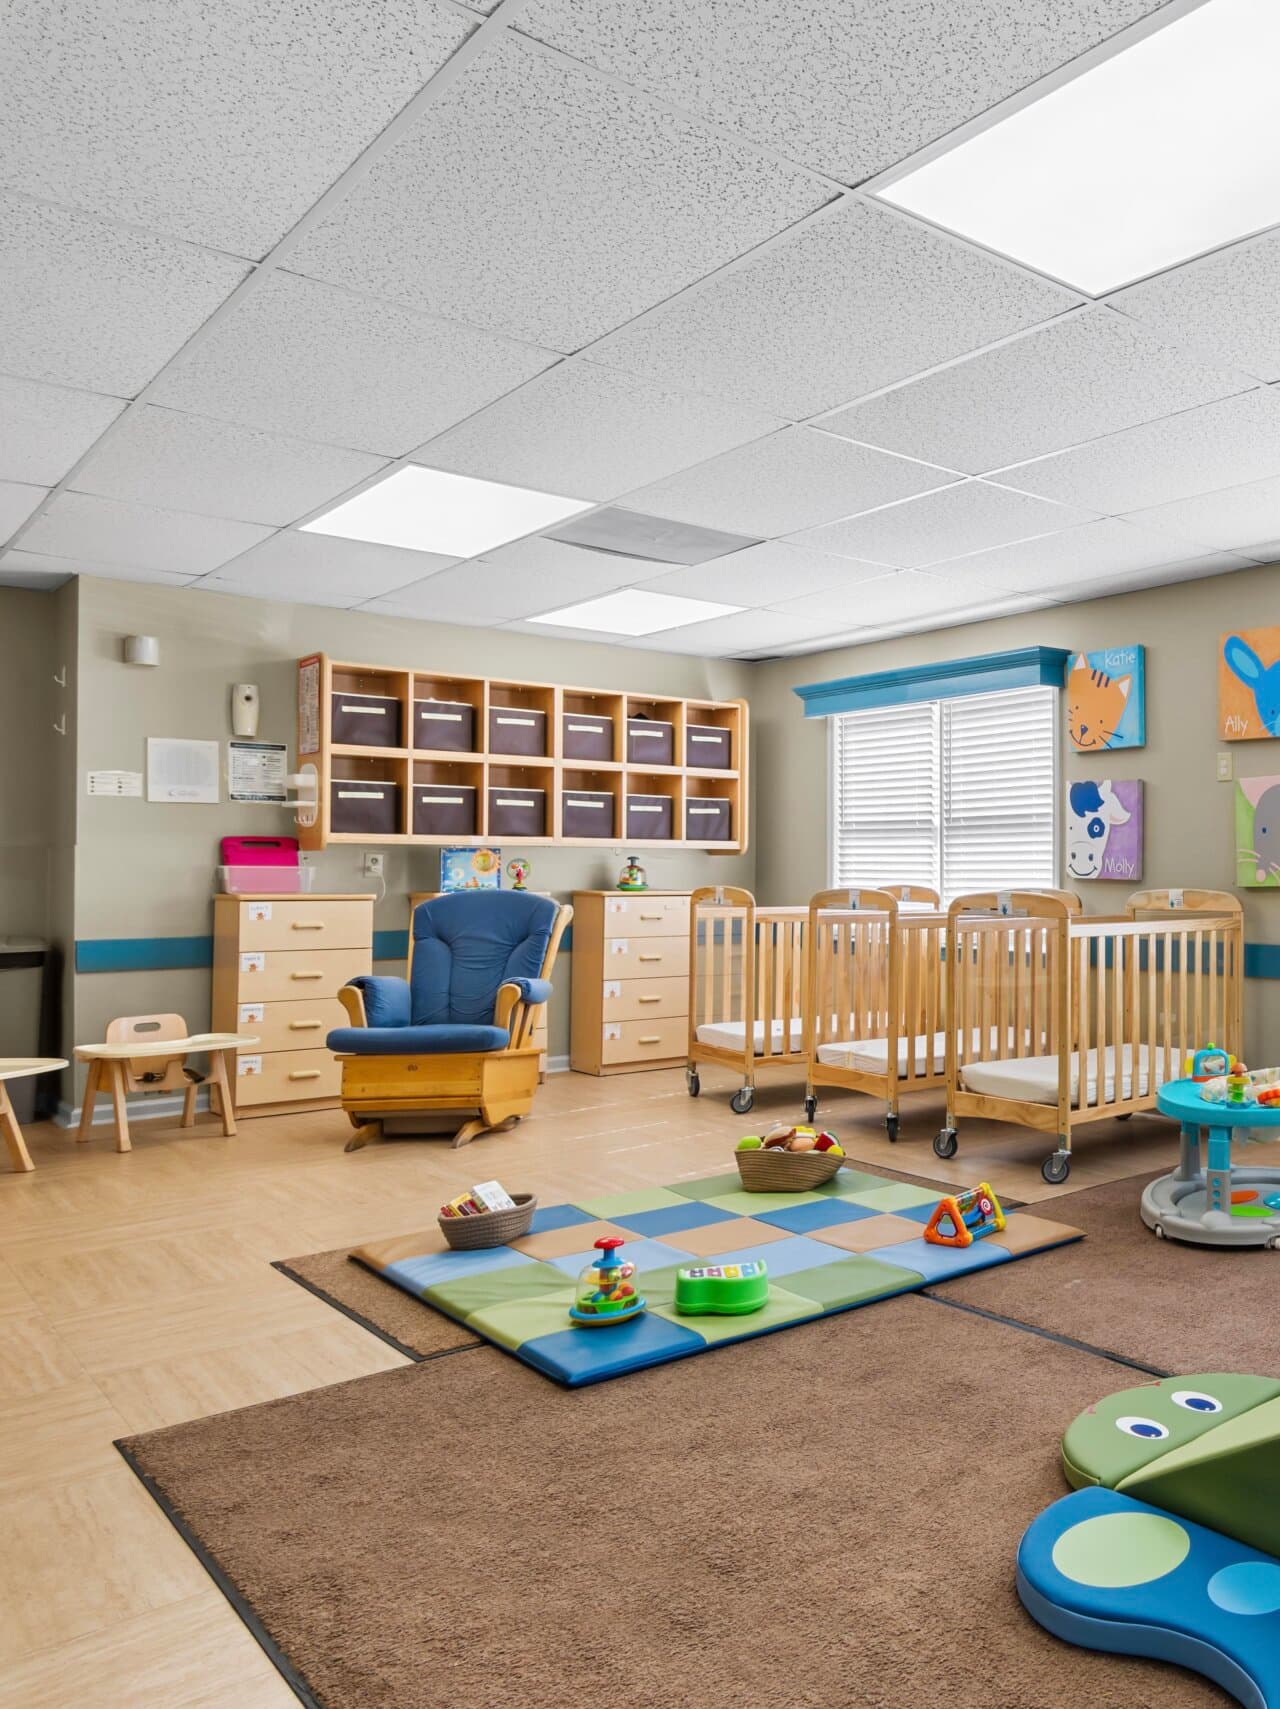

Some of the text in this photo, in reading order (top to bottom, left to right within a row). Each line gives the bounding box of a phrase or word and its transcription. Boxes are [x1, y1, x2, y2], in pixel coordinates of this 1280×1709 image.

[1104, 648, 1136, 668] Katie
[1224, 715, 1249, 737] Ally
[1104, 856, 1135, 879] Molly
